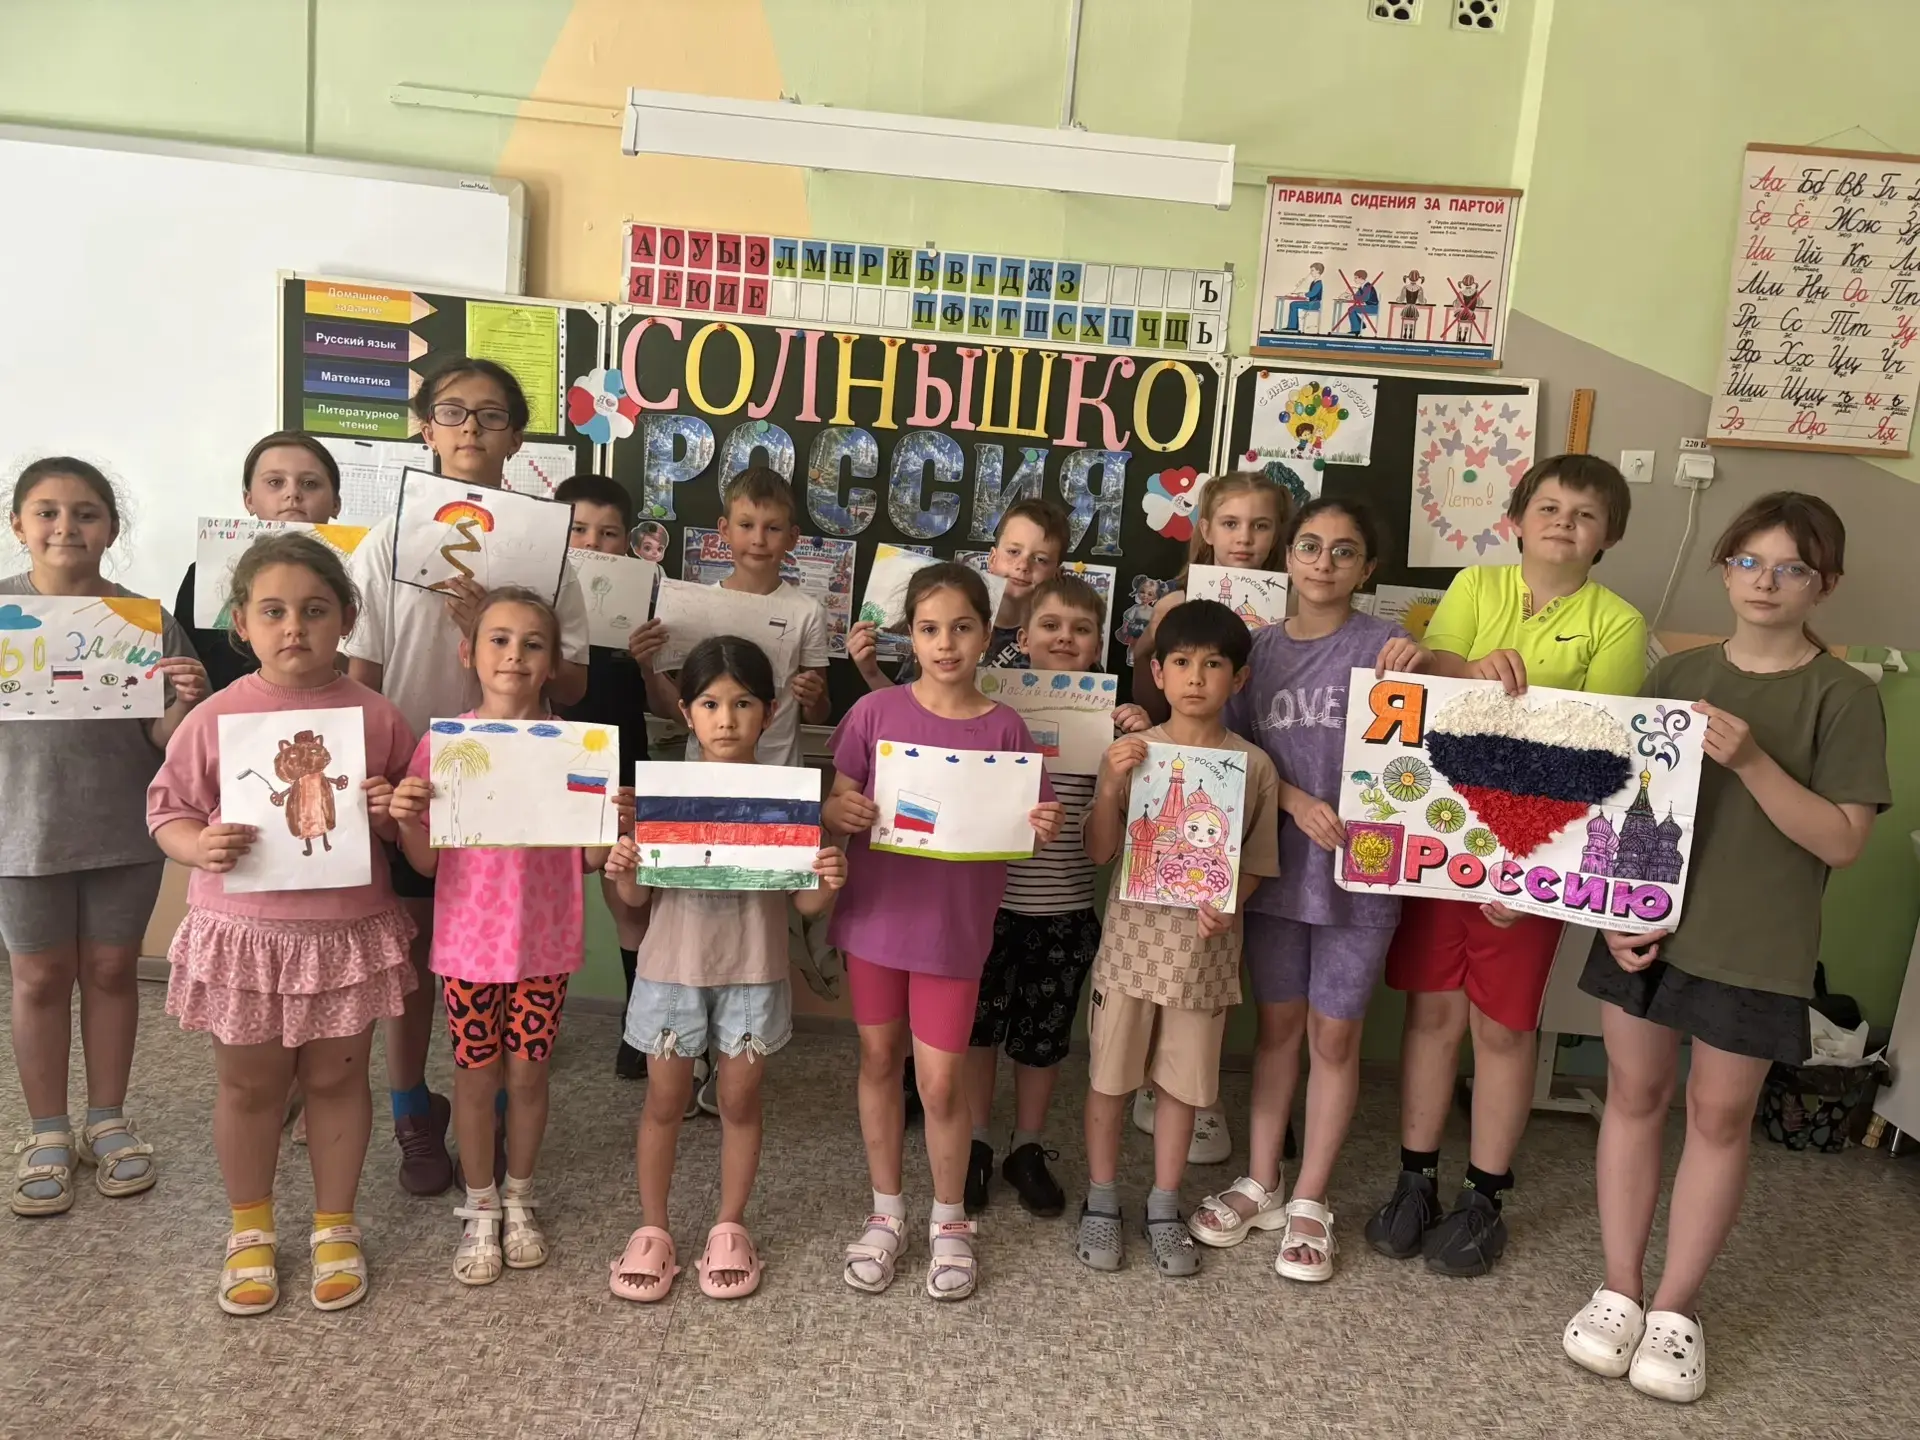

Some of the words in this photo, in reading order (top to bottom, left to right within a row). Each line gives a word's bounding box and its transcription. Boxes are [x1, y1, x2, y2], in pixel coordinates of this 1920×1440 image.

[1750, 165, 1787, 192] Аа
[1797, 168, 1839, 194] Бб
[1835, 171, 1868, 197] Вв
[1873, 173, 1901, 200] Гг
[1278, 189, 1342, 205] ПРАВИЛА
[1350, 193, 1417, 210] СИДЕНИЯ
[1424, 198, 1440, 211] ЗА
[1449, 198, 1505, 214] ПАРТОЙ
[1745, 234, 1776, 260] Ии
[1793, 235, 1824, 264] Йй
[1841, 242, 1873, 268] Кк
[634, 233, 654, 257] А
[663, 235, 681, 259] О
[691, 237, 710, 262] У
[717, 240, 741, 264] Ы
[750, 243, 766, 267] Э
[776, 246, 795, 270] Л
[805, 248, 827, 273] М
[834, 251, 853, 275] Н
[862, 253, 878, 277] Р
[890, 250, 908, 280] Й
[918, 258, 934, 282] Б
[947, 260, 964, 284] В
[975, 263, 992, 287] Г
[1001, 265, 1021, 295] Д
[1028, 268, 1052, 292] Ж
[1060, 270, 1075, 294] З
[1199, 279, 1219, 303] Ъ
[328, 287, 390, 303] Домашнее
[1737, 269, 1785, 296] Мм
[1796, 273, 1830, 300] Нн
[1843, 277, 1870, 302] Оо
[335, 303, 382, 315] задание
[633, 274, 652, 297] Я
[663, 272, 680, 300] Ё
[686, 280, 710, 304] Ю
[717, 282, 737, 307] И
[748, 285, 764, 309] Е
[914, 299, 935, 324] П
[942, 302, 964, 326] Ф
[972, 304, 990, 328] К
[1001, 307, 1017, 331] Т
[1025, 309, 1048, 333] Ш
[1056, 312, 1073, 336] С
[1082, 313, 1103, 338] Х
[1110, 315, 1131, 345] Ц
[1140, 317, 1159, 342] Ч
[1164, 320, 1188, 344] Щ
[1196, 321, 1213, 345] Ь
[316, 332, 364, 347] Русский
[367, 339, 397, 349] язык
[1730, 338, 1762, 372] Фф
[1774, 340, 1815, 367] Хх
[1828, 344, 1862, 375] Цц
[1881, 347, 1906, 373] Чч
[321, 371, 391, 387] Математика
[622, 316, 1201, 452] СОЛНЫШКО
[317, 403, 400, 420] Литературное
[338, 420, 379, 431] чтение
[1720, 405, 1745, 430] Ээ
[1787, 410, 1828, 435] Юю
[1868, 415, 1898, 441] Яя
[1685, 440, 1699, 448] 220
[637, 413, 1133, 557] РОССИЯ
[1441, 466, 1494, 509] Лето!
[703, 534, 719, 548] 12
[1240, 575, 1268, 597] РОССИЯ
[1255, 685, 1347, 730] LOVE
[1362, 680, 1429, 748] Я
[1194, 756, 1225, 781] РОССИЯ
